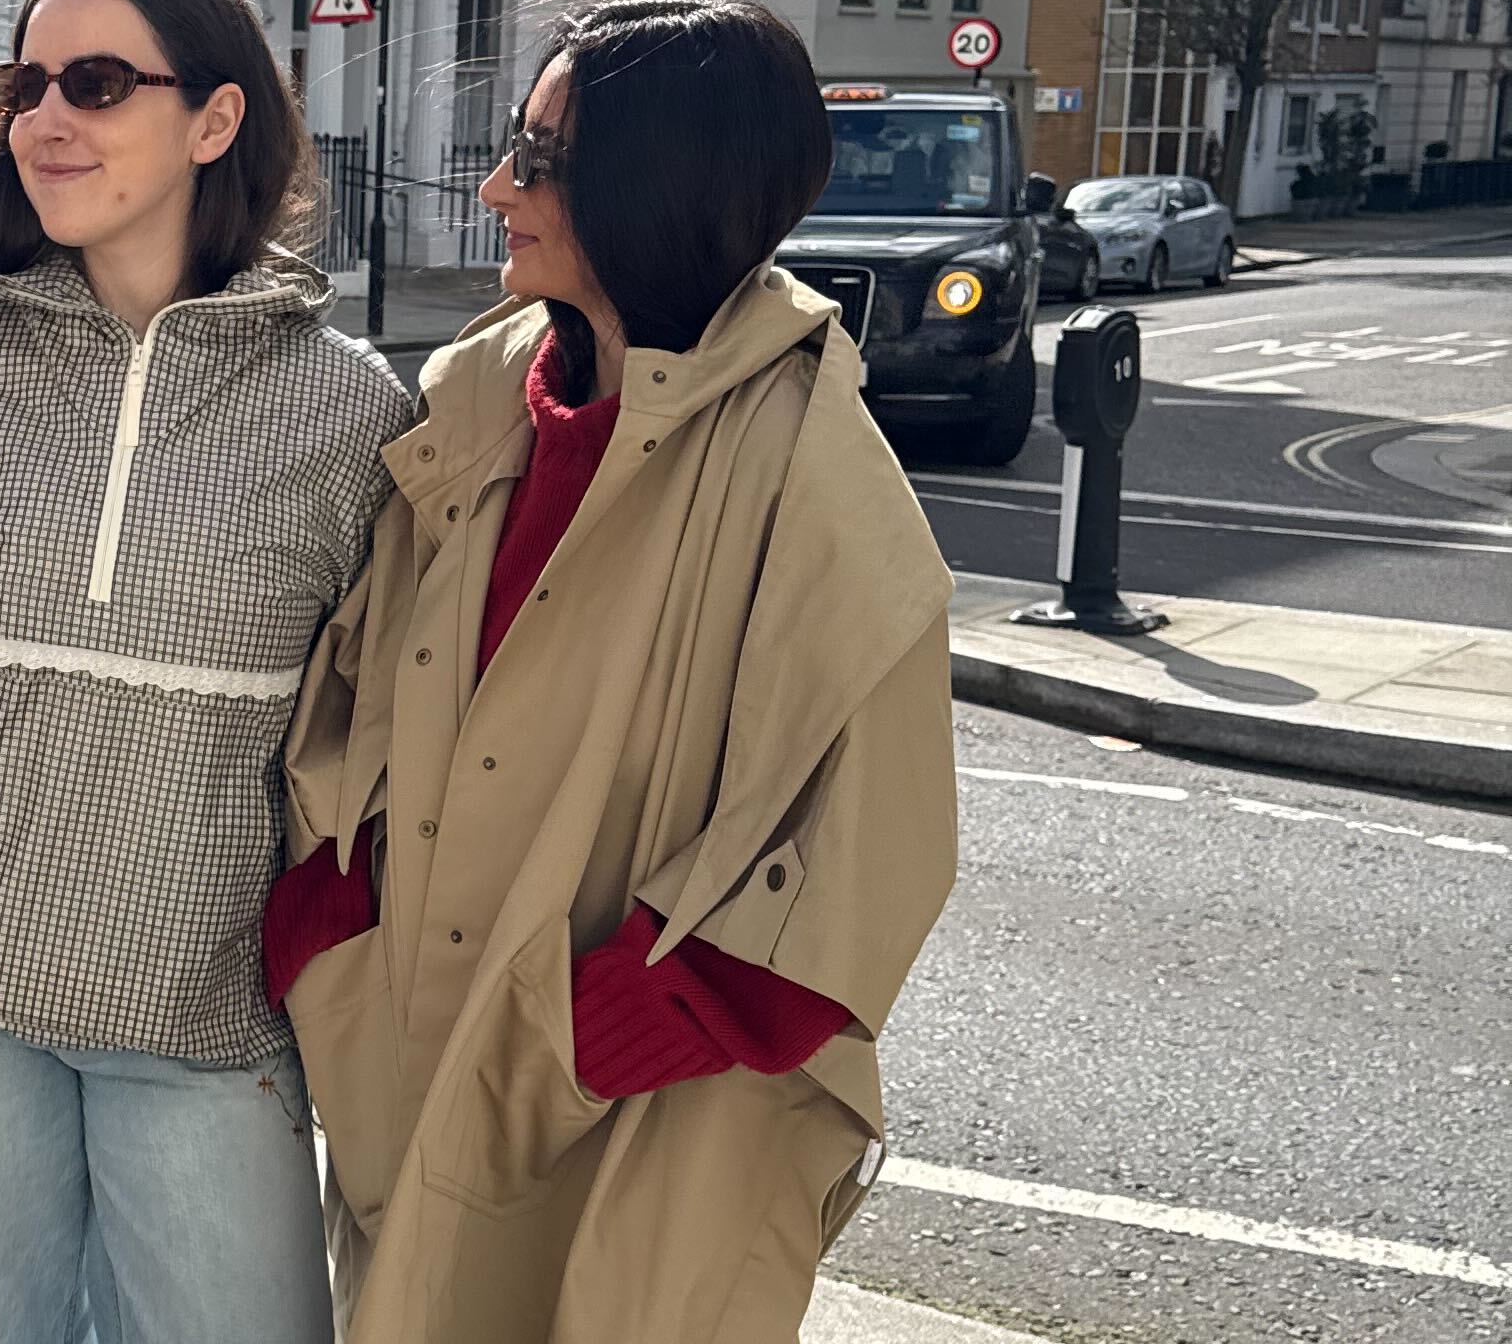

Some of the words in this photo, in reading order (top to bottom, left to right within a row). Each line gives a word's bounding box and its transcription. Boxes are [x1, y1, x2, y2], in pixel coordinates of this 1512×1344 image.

[956, 33, 991, 54] 20
[1211, 338, 1509, 367] TURN
[1114, 354, 1133, 383] 10
